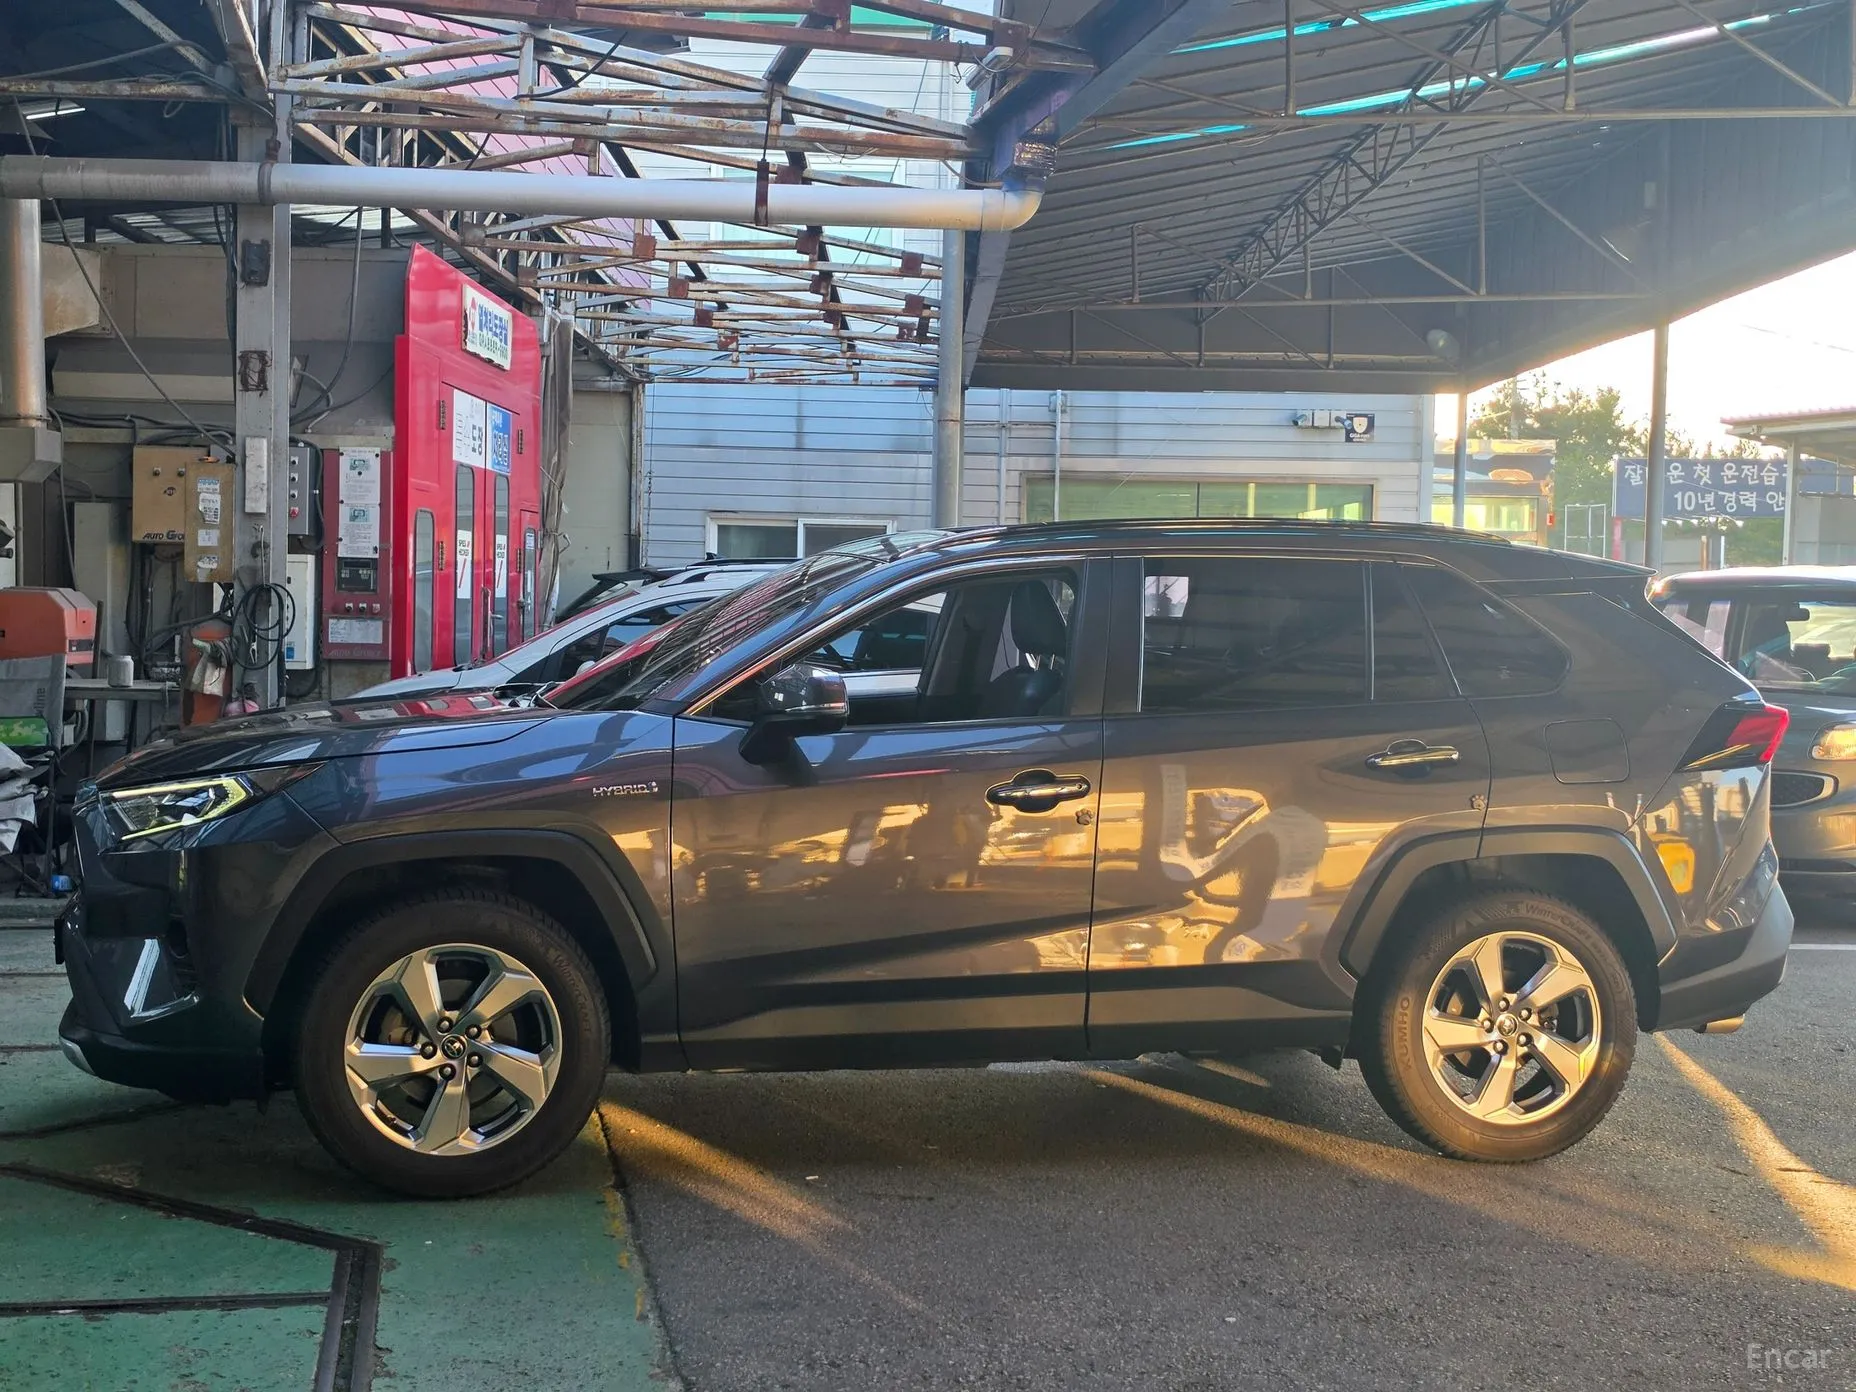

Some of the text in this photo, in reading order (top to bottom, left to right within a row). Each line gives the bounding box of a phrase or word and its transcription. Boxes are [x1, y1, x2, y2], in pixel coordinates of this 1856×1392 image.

[1624, 464, 1643, 486] 잘
[1693, 463, 1713, 486] 첫
[142, 531, 164, 540] AUTO
[592, 783, 650, 797] HYBRID
[1398, 997, 1412, 1072] KUMHO
